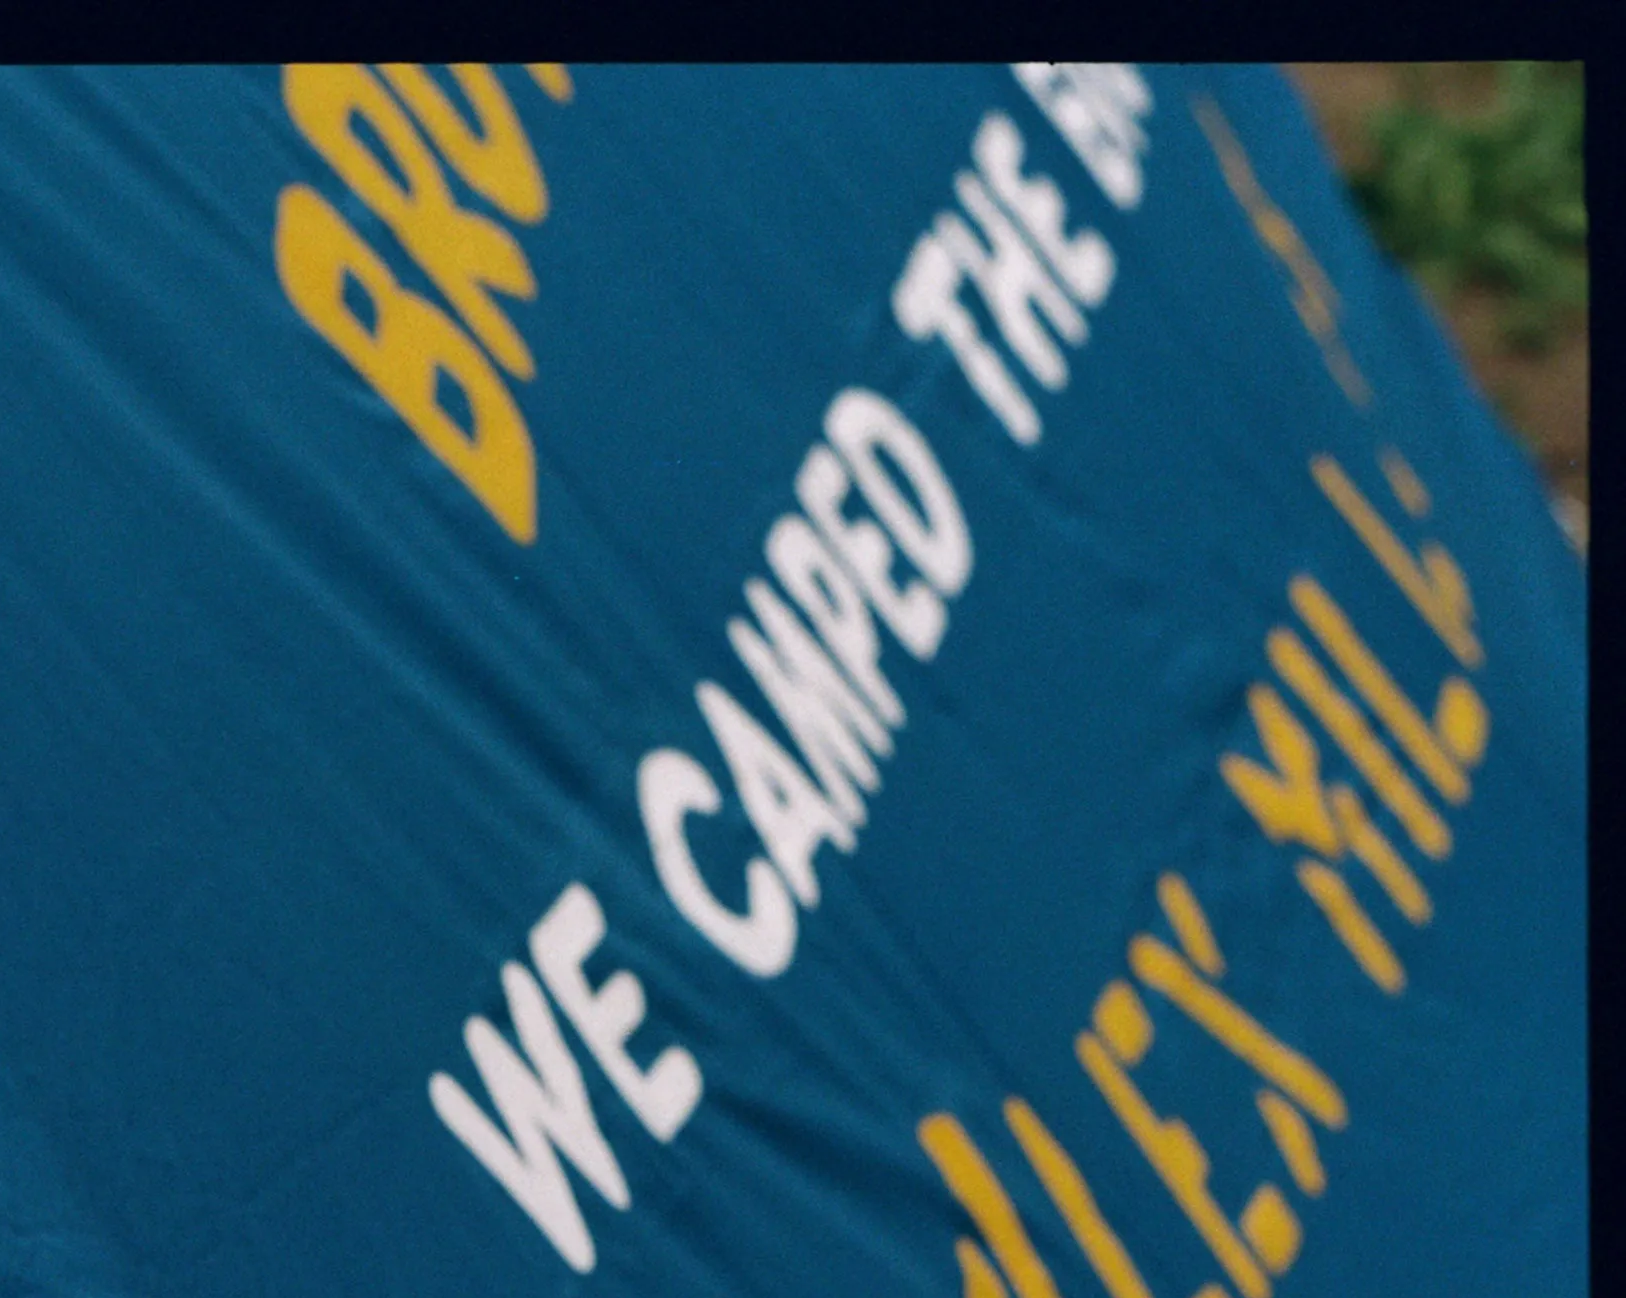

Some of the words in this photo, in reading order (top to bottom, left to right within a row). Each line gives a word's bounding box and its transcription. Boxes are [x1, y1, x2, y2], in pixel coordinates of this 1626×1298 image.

[275, 63, 574, 546] BRU
[429, 881, 704, 1273] WE
[636, 386, 974, 979] CAMPED
[891, 107, 1118, 448] THE
